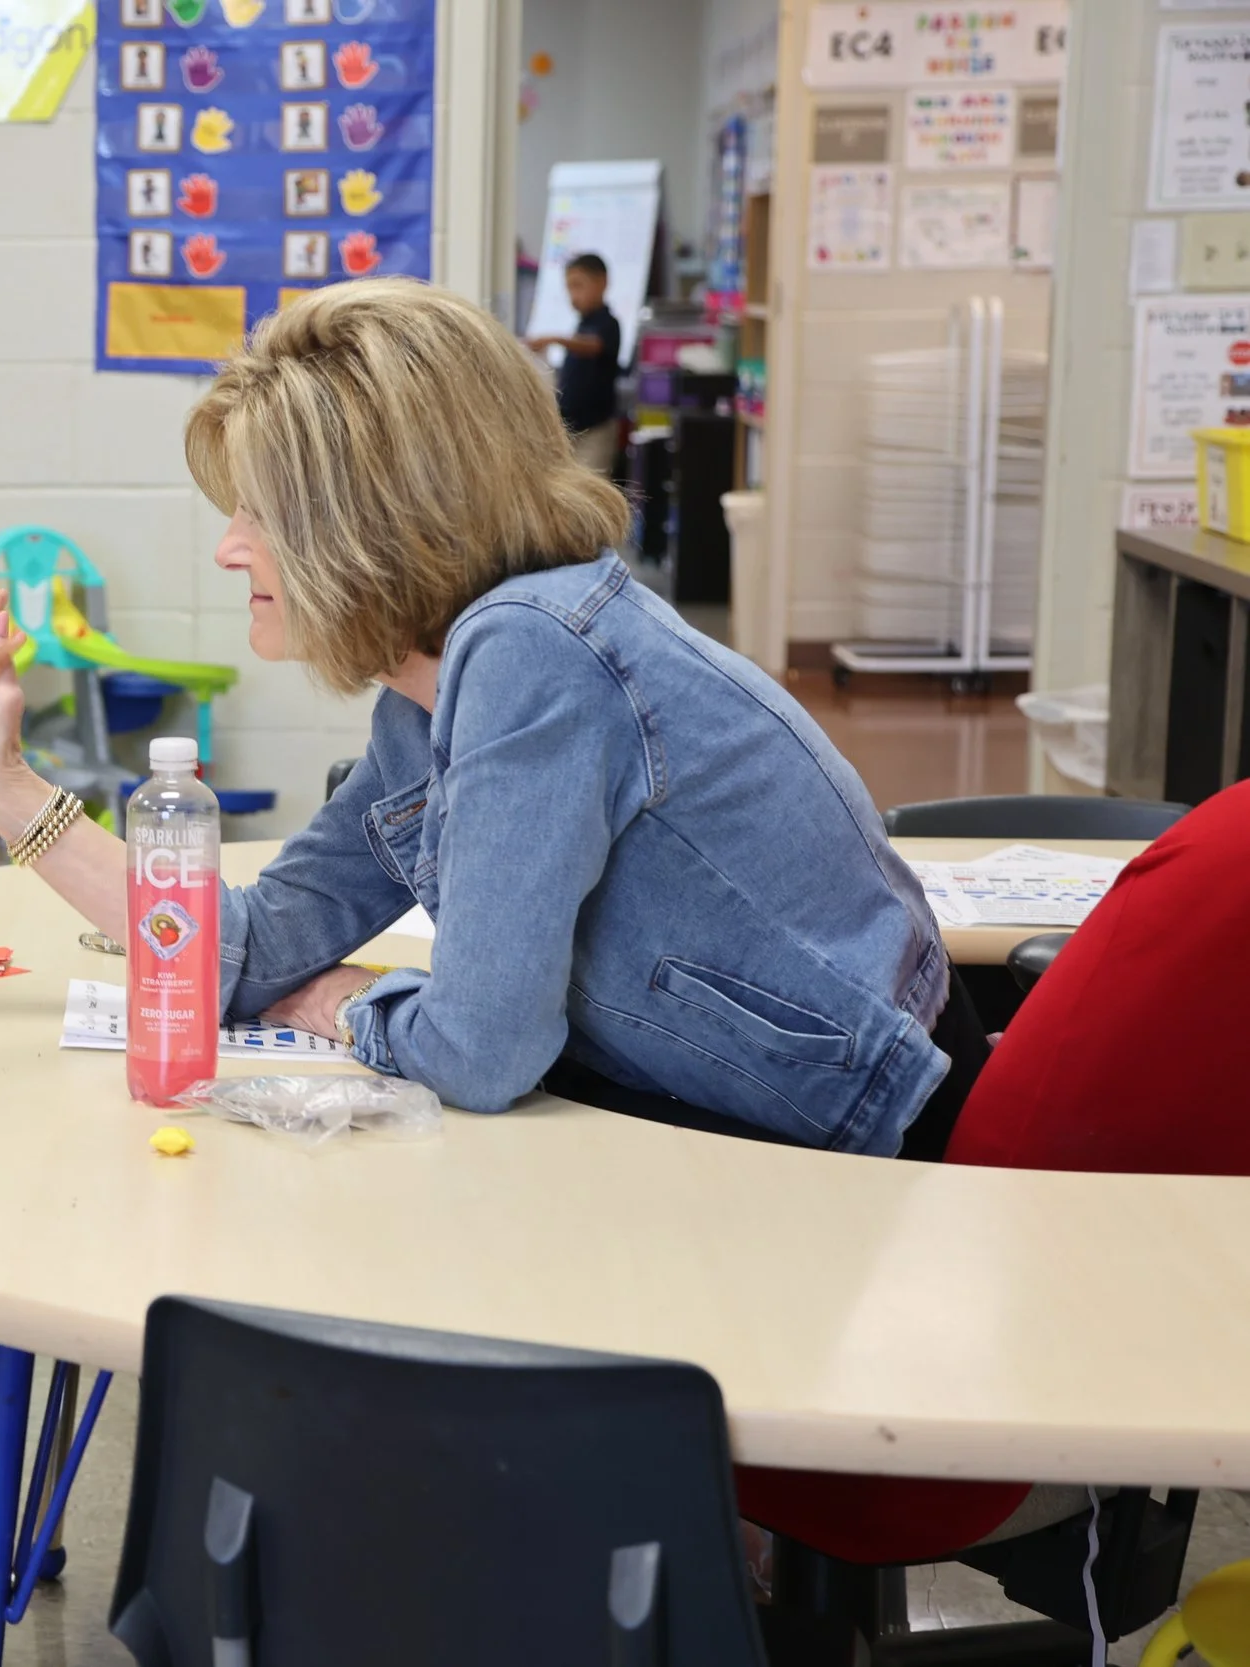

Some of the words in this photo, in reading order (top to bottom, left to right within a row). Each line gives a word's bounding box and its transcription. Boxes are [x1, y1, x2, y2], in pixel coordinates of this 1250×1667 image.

[831, 31, 893, 60] EC4
[135, 826, 205, 846] SPARKLING
[141, 977, 193, 988] STRAWBERRY
[140, 1007, 162, 1020] ZERO
[164, 1008, 195, 1021] SUGAR
